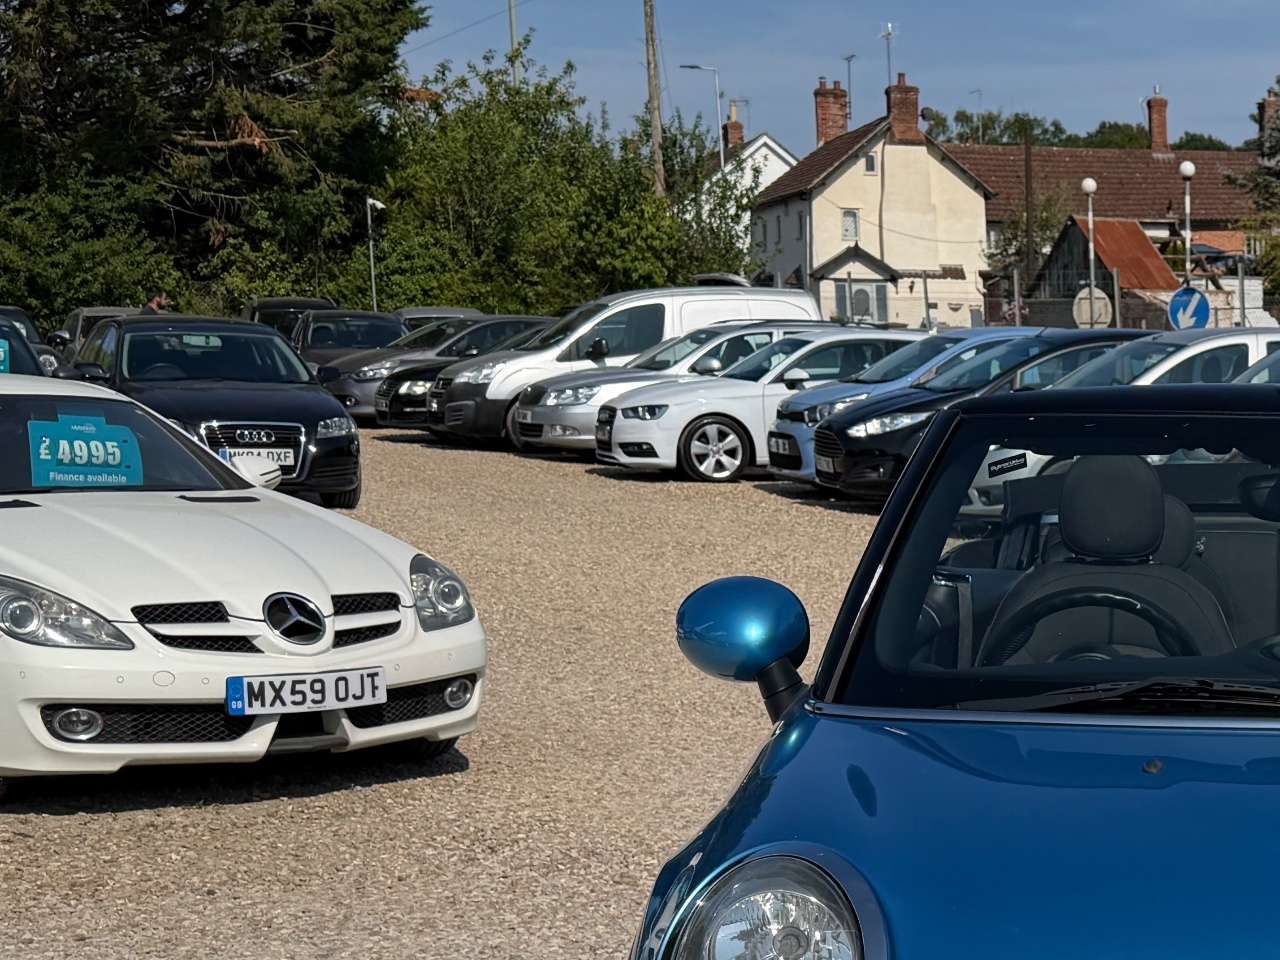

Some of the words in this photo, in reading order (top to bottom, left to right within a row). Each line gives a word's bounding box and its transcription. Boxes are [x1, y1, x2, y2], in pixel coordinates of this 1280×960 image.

[49, 471, 85, 482] Finance
[87, 473, 127, 483] available
[246, 678, 327, 708] MX59
[334, 671, 379, 703] OJT
